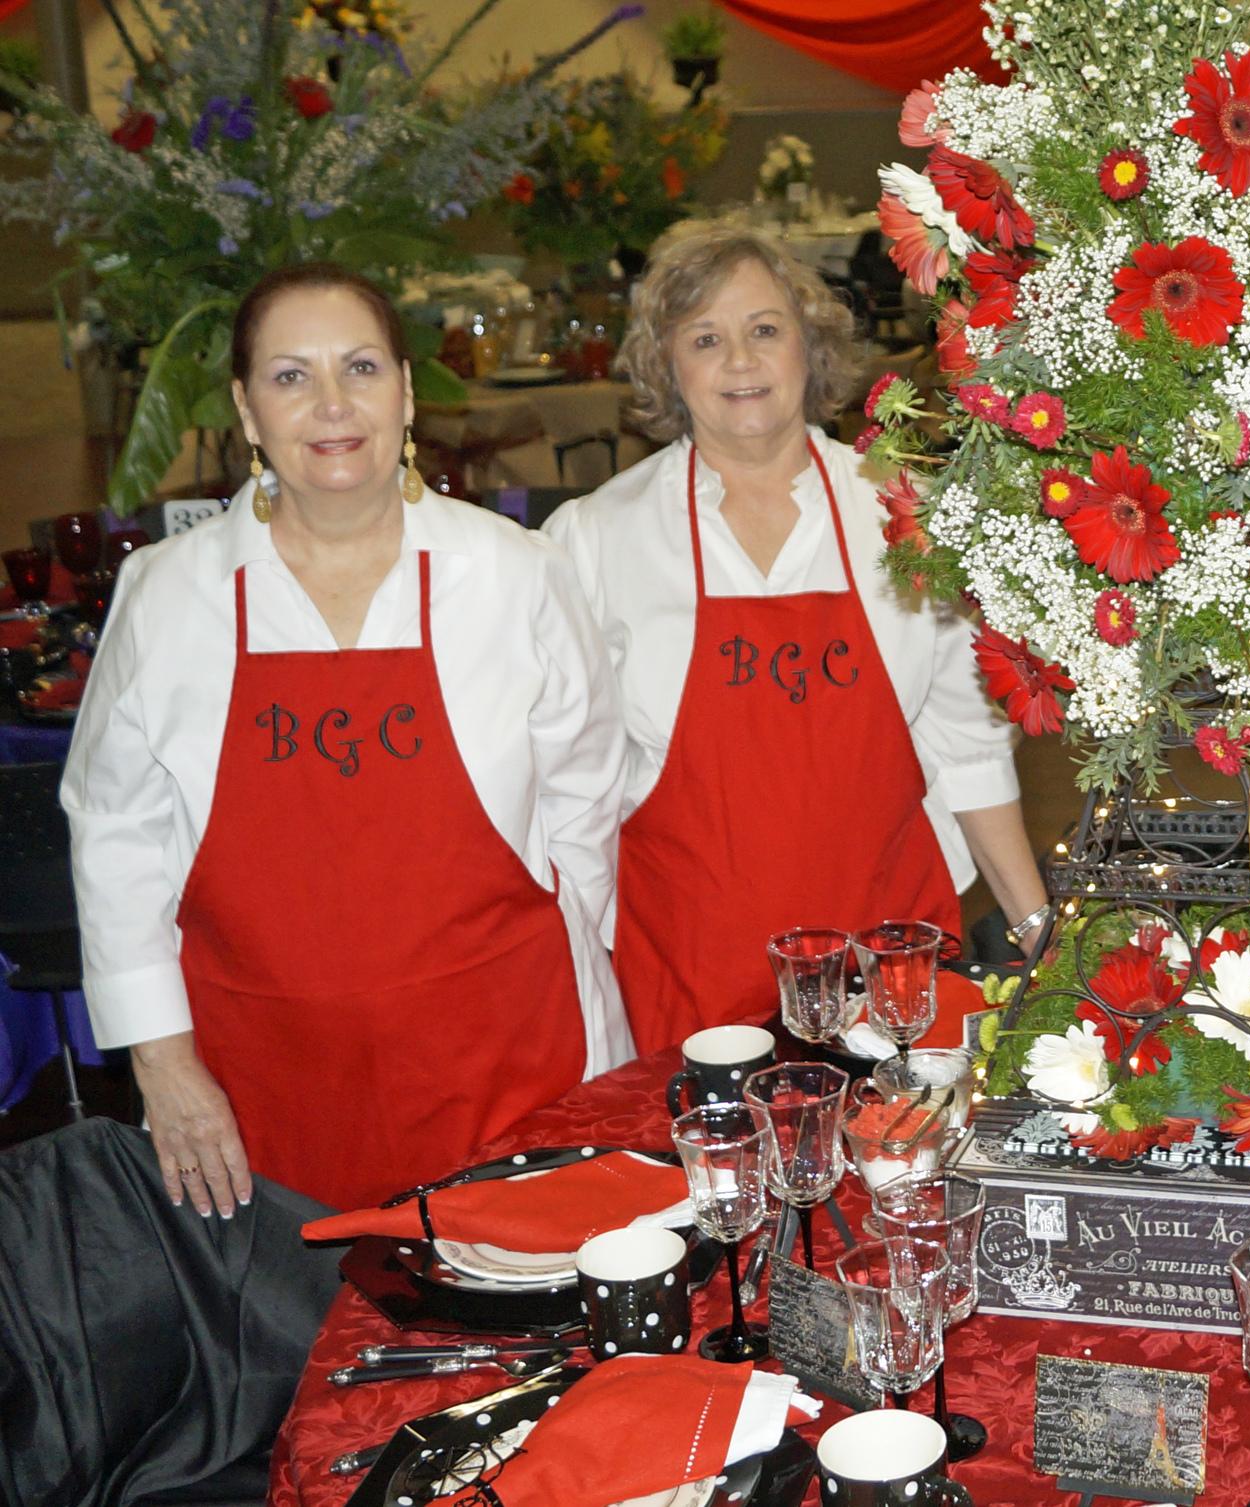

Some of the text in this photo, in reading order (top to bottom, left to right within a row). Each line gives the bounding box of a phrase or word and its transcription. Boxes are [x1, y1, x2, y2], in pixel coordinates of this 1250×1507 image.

[719, 634, 858, 704] BGC
[256, 703, 422, 777] BGC
[984, 1208, 1021, 1223] aris
[1041, 1219, 1052, 1233] 15
[998, 1247, 1029, 1262] 950
[1142, 1259, 1233, 1277] ATELIERS
[1128, 1281, 1238, 1306] FABRIQU
[1212, 1306, 1246, 1322] Trio
